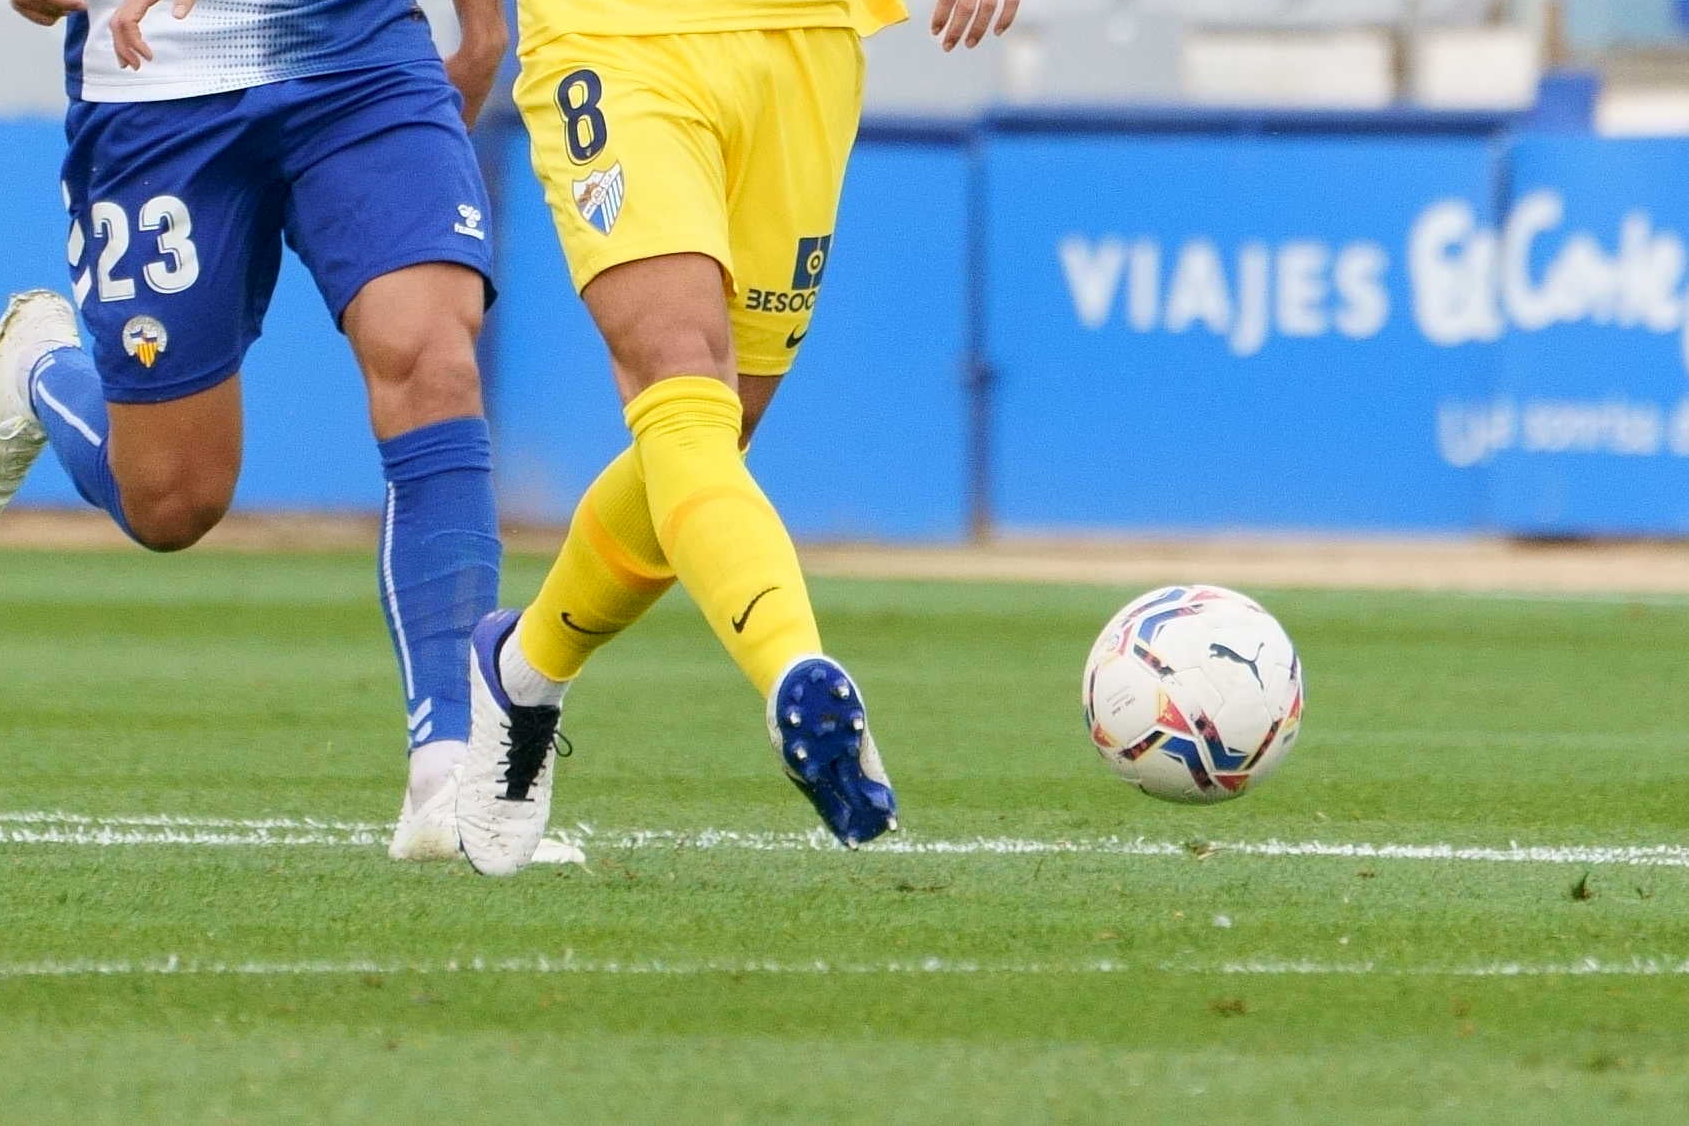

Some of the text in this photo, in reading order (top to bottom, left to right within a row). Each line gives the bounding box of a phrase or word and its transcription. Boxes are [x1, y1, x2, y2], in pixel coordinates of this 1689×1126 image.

[555, 69, 607, 165] 8
[91, 195, 199, 302] 23
[1059, 235, 1391, 357] VIAJES
